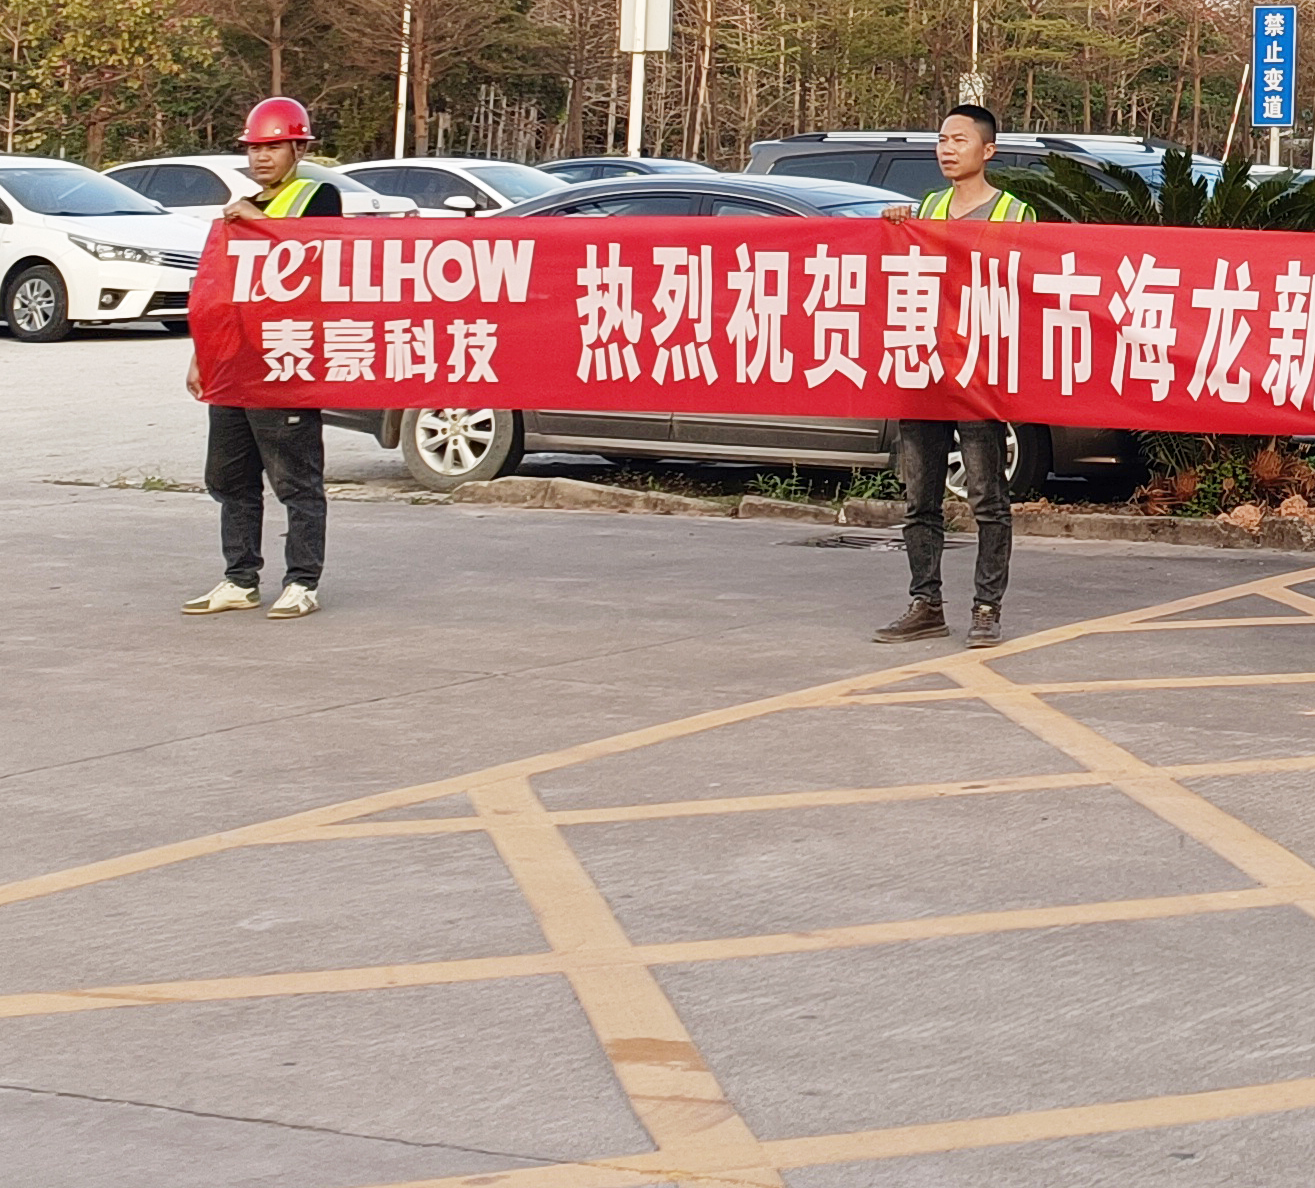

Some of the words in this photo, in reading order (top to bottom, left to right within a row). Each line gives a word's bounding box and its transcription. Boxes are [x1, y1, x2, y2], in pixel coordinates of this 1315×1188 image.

[1262, 12, 1285, 119] 禁止变道
[261, 318, 499, 384] 泰豪科技
